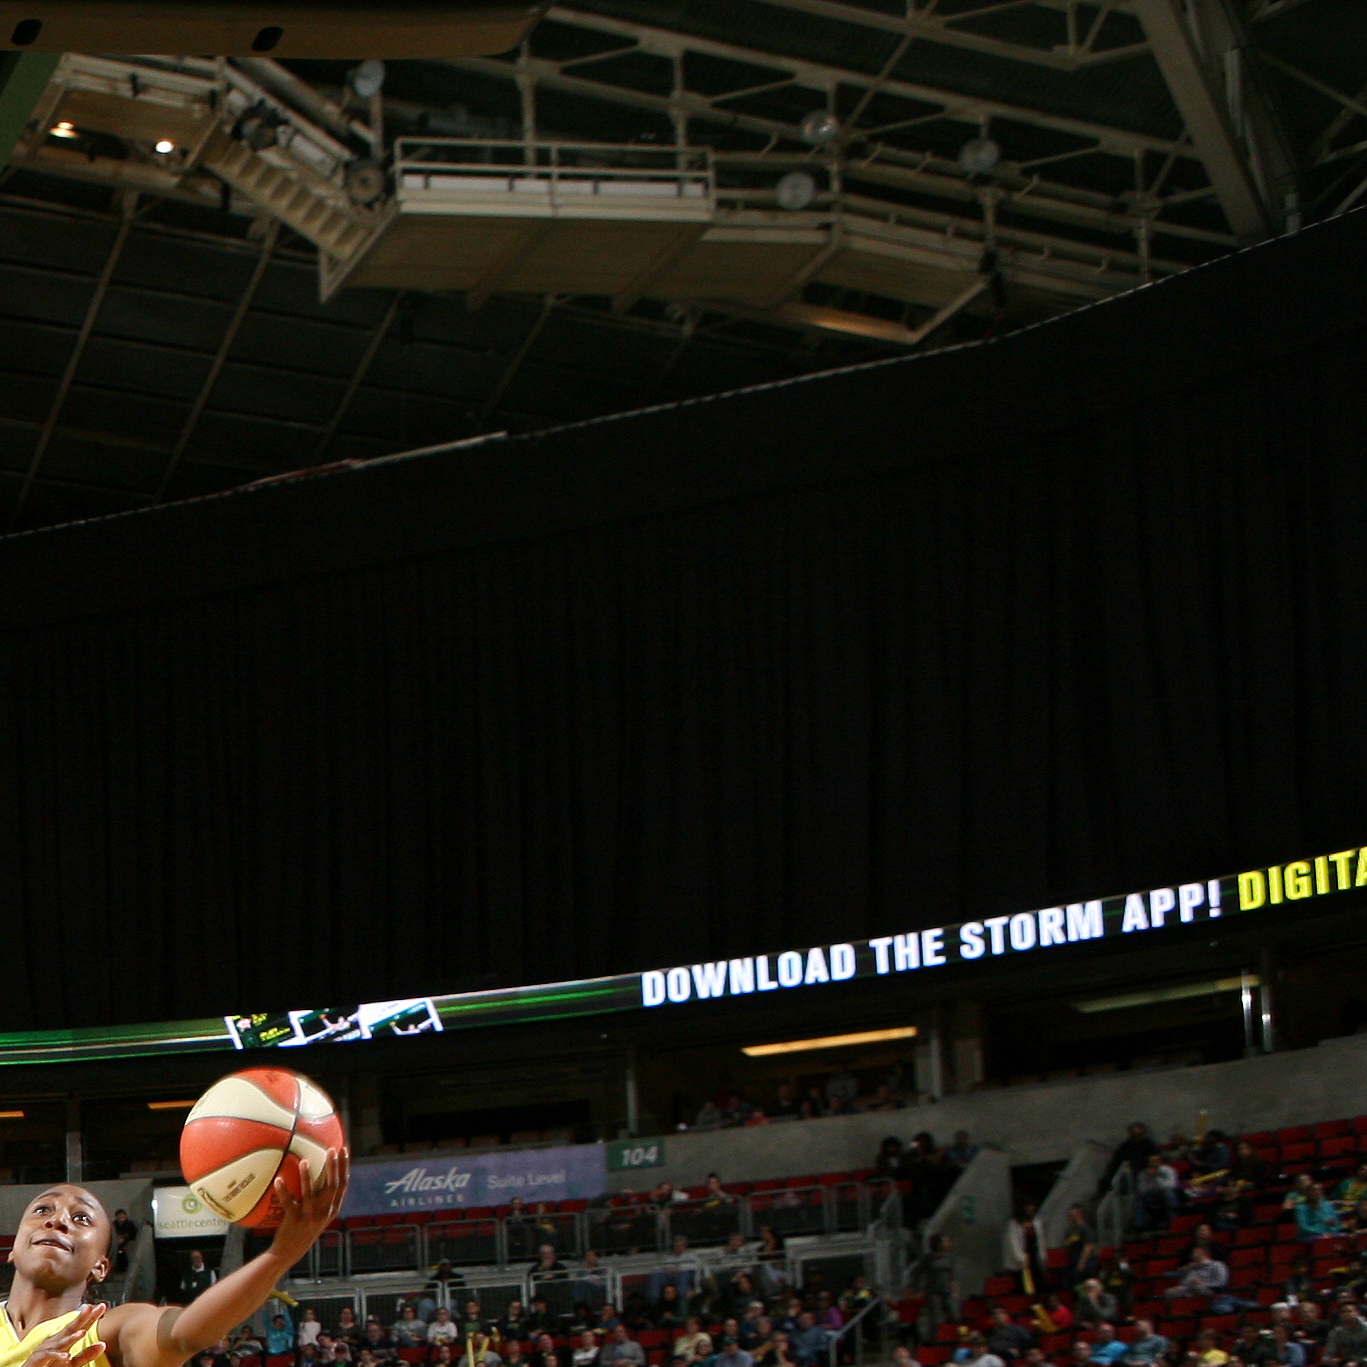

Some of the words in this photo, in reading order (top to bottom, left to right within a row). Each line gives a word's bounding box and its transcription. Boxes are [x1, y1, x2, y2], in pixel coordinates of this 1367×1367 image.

[642, 943, 857, 1008] DOWNLOAD
[870, 933, 946, 975] THE
[959, 900, 1105, 962] STORM
[1122, 879, 1222, 935] APP!
[621, 1146, 658, 1167] 104
[385, 1166, 472, 1194] Alaska
[486, 1174, 525, 1190] Suite
[529, 1169, 566, 1186] Level
[391, 1193, 464, 1208] AIRLINES
